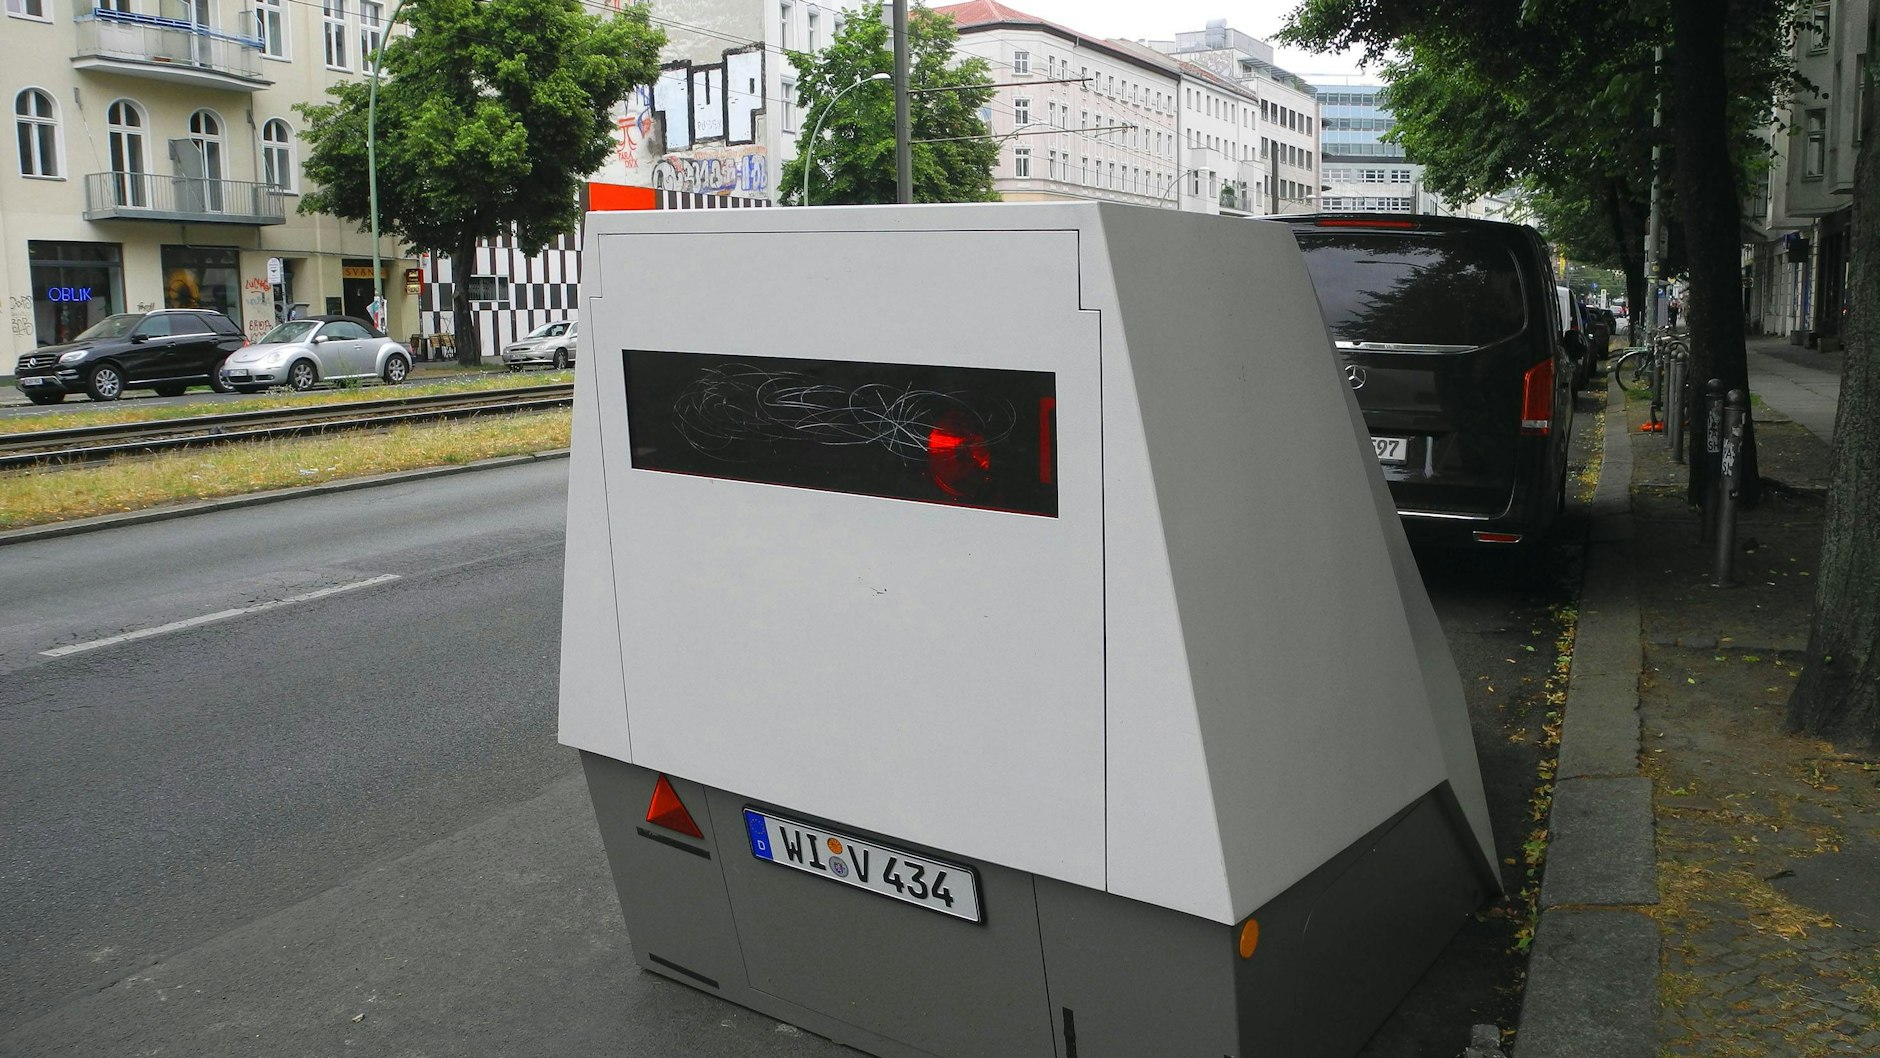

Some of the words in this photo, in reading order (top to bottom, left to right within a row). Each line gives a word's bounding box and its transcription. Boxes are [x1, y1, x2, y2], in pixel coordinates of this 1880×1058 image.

[48, 287, 93, 302] OBLIK
[1372, 439, 1400, 457] 97
[757, 839, 766, 851] D
[779, 825, 827, 871] WI
[846, 844, 870, 883] V
[883, 856, 954, 908] 434
